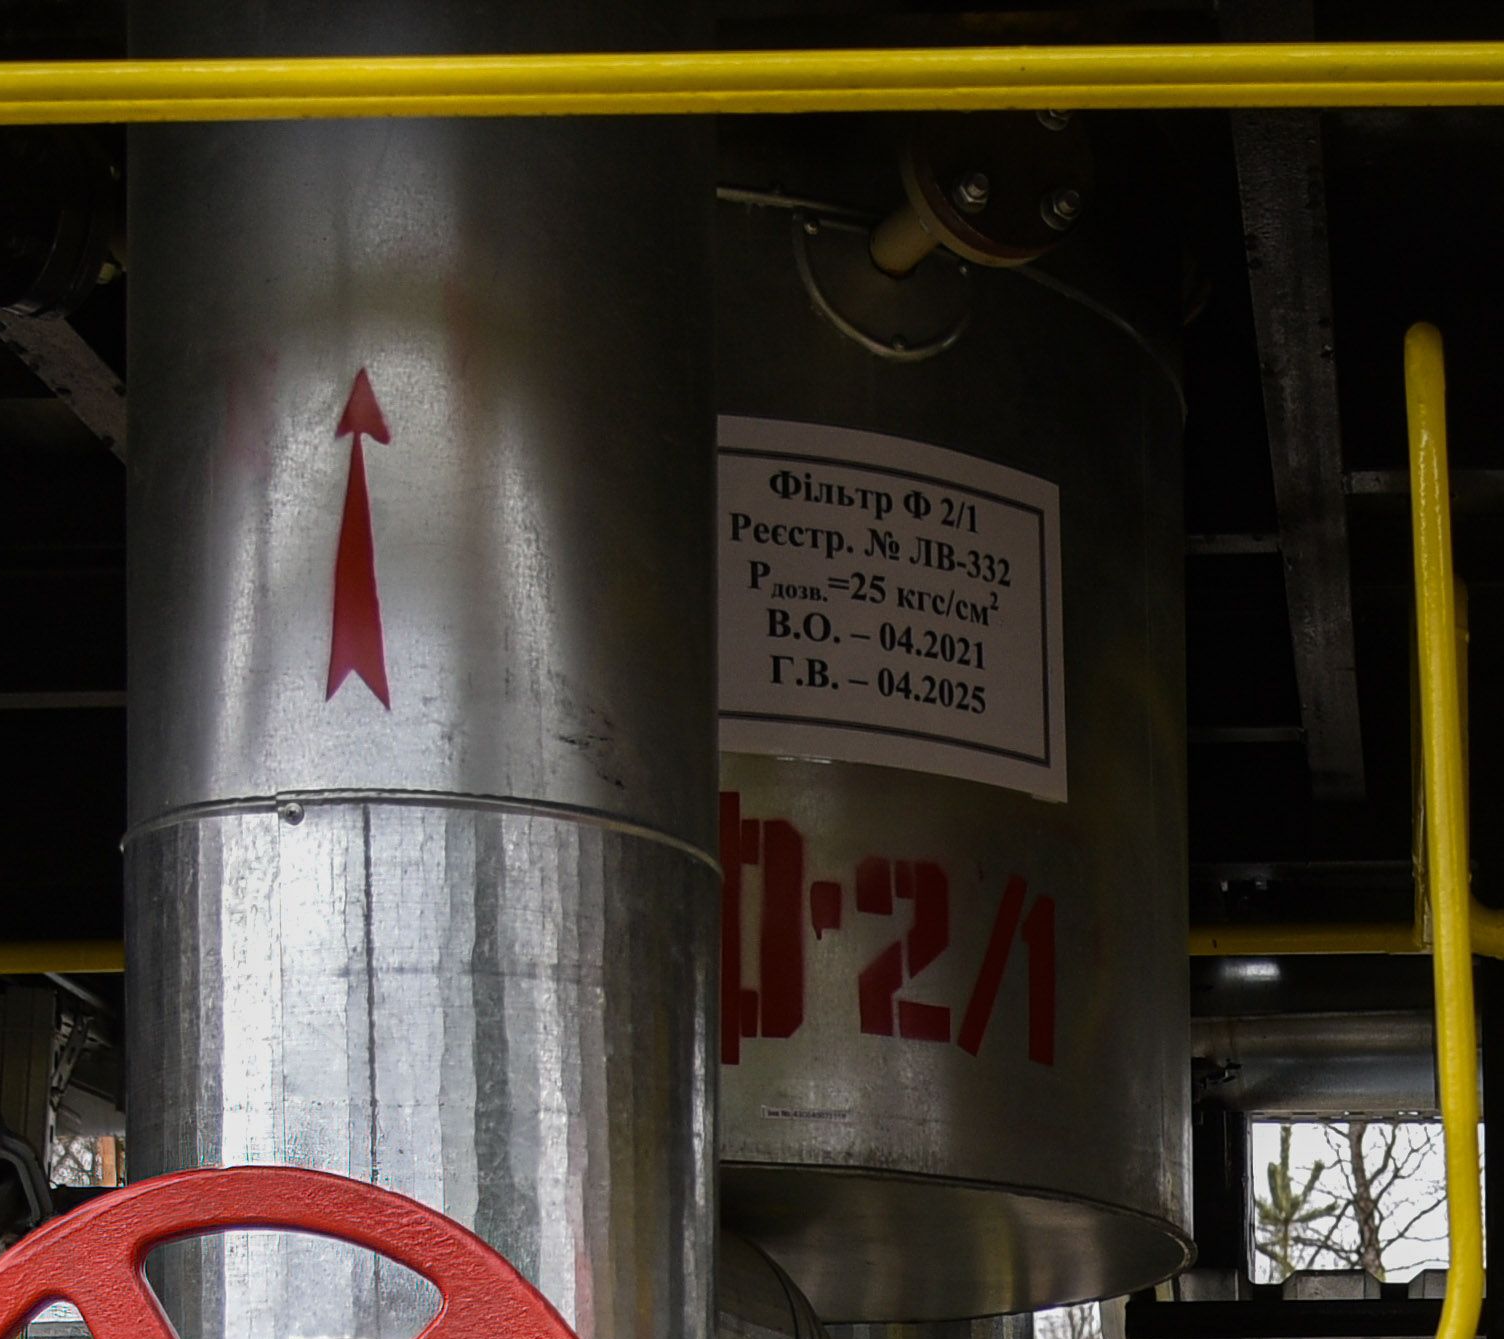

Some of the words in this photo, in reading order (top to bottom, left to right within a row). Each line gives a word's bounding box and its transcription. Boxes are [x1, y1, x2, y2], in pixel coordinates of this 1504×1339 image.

[769, 470, 893, 520] Фільтр
[903, 490, 931, 520] Ф
[940, 498, 979, 534] 2/1
[729, 512, 853, 559] Реєстр.
[865, 528, 901, 561] №
[910, 536, 1011, 588] ЛВ-332
[766, 608, 841, 645] В.О.
[879, 622, 986, 670] 04.2021
[769, 655, 839, 690] Г.В.
[877, 668, 986, 714] 04.2025
